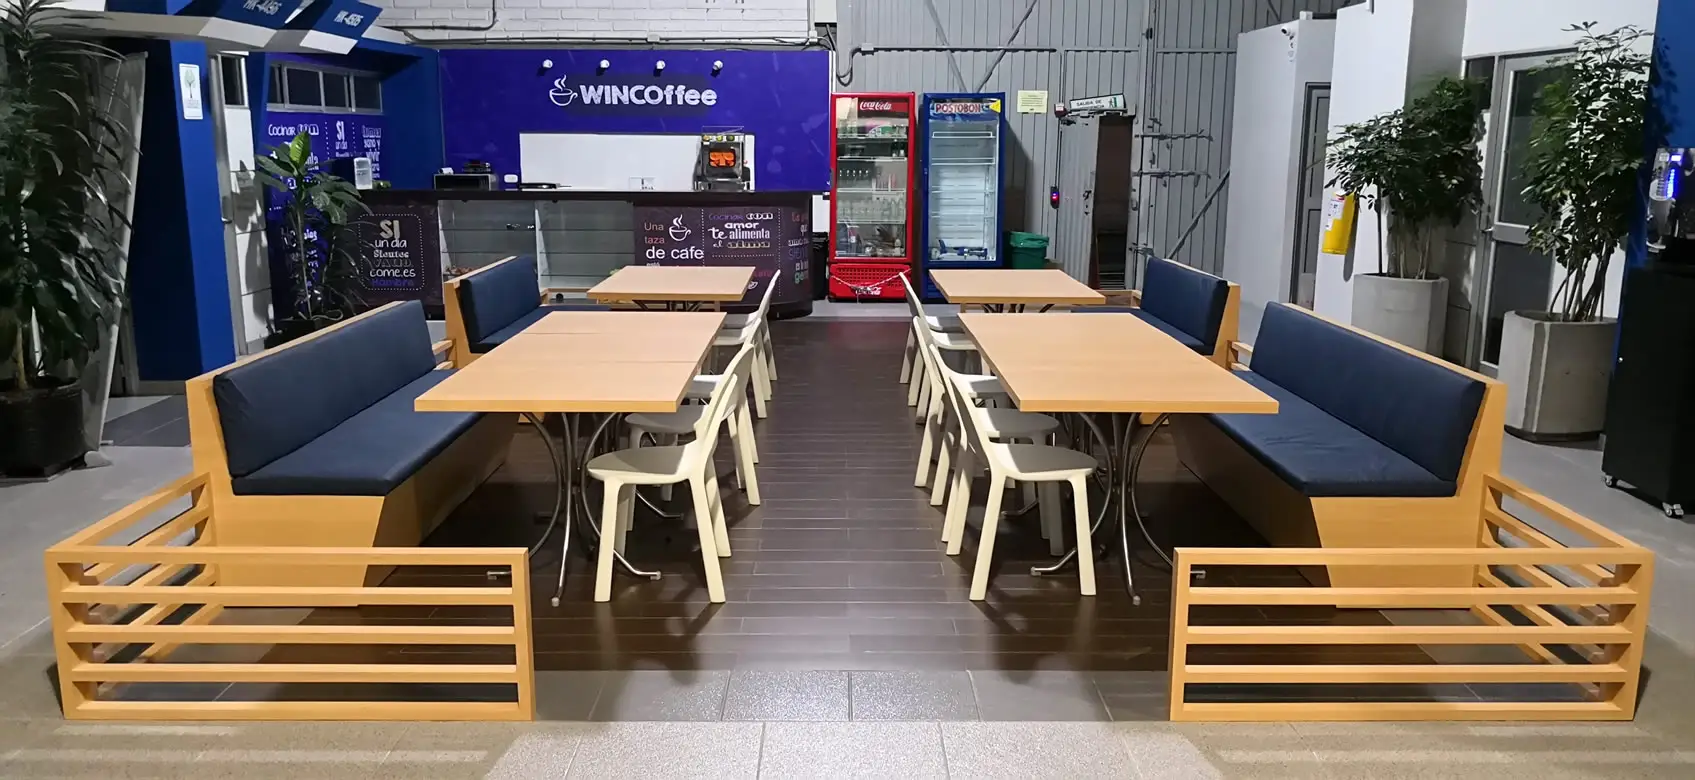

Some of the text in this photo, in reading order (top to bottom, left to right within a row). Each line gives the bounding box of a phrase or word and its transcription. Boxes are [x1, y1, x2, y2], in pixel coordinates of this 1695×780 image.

[579, 84, 718, 106] WINCOffee
[643, 222, 664, 231] Una
[707, 227, 771, 240] te alimenta
[374, 239, 389, 248] un
[644, 236, 665, 244] taza
[645, 246, 666, 259] de
